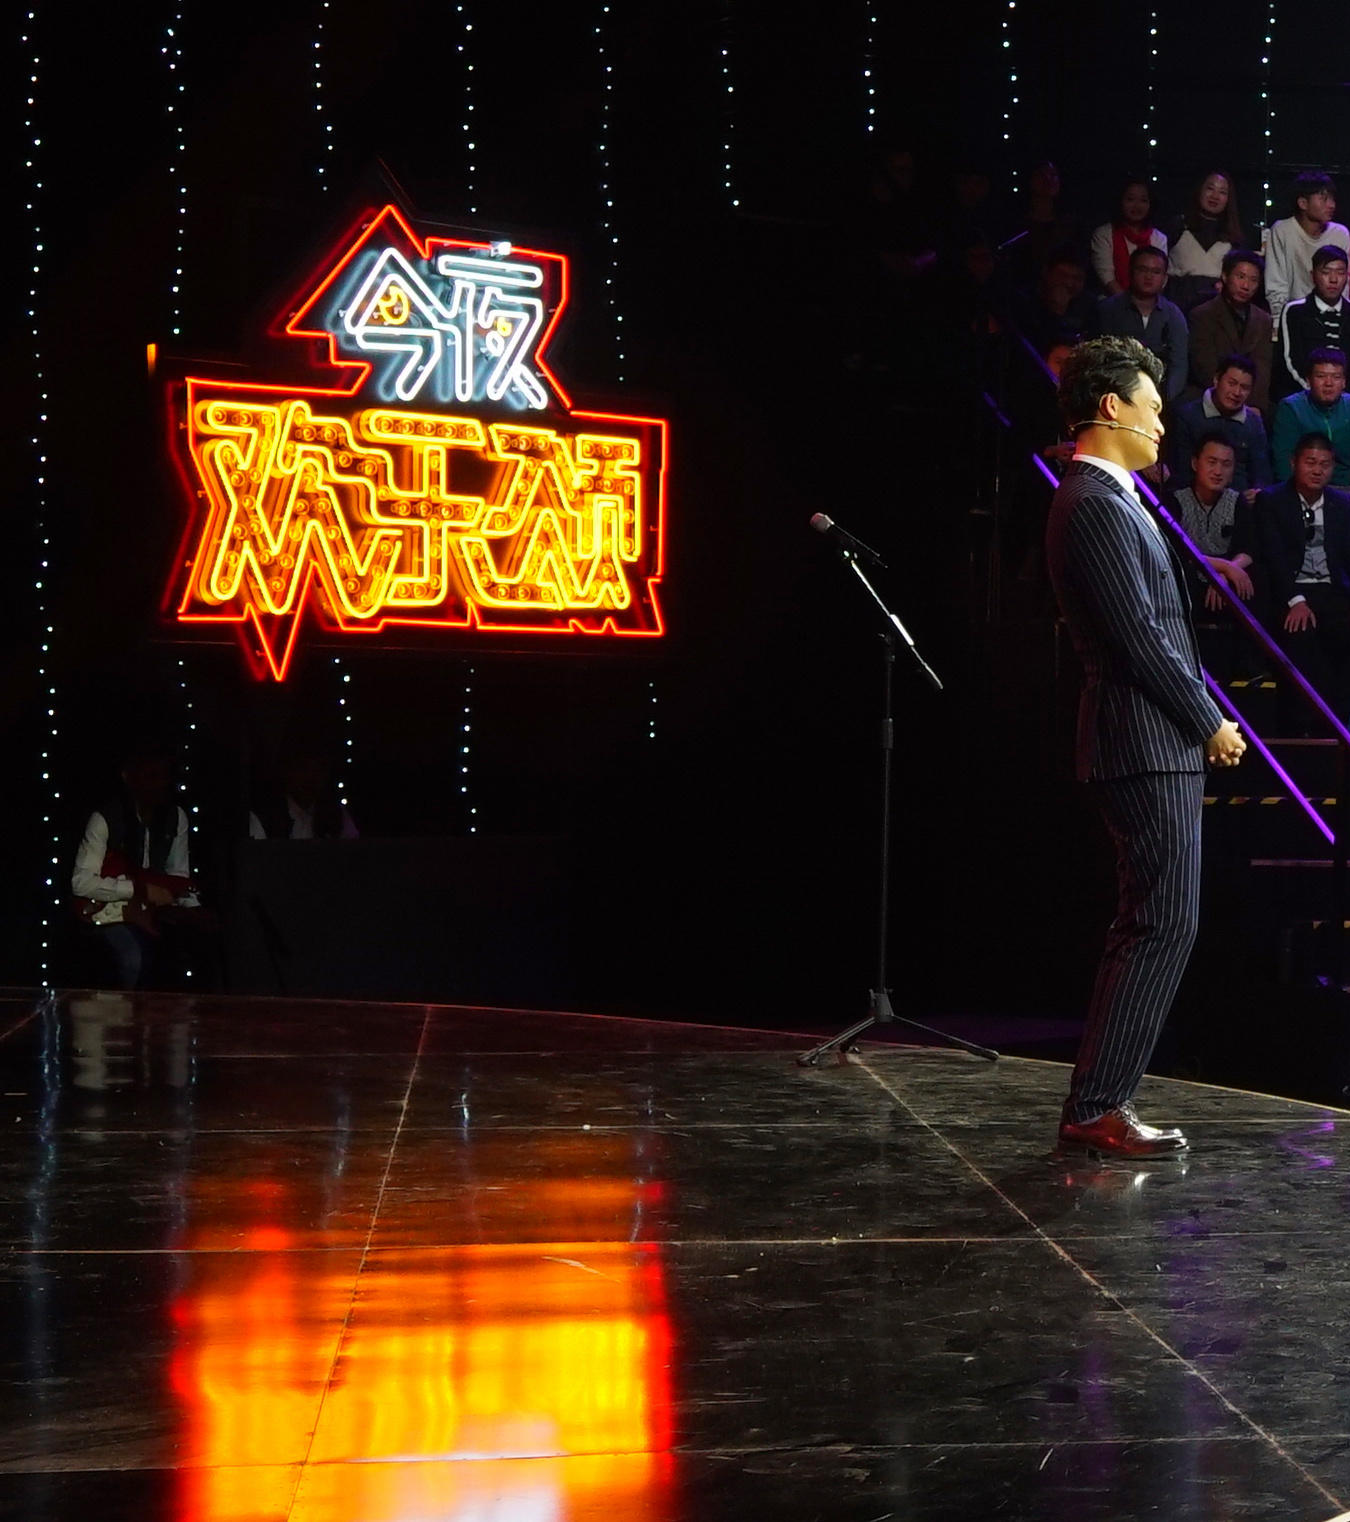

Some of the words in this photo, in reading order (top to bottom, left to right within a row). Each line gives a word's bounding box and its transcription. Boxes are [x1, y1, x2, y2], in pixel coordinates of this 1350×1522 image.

[342, 246, 549, 411] 今夜
[198, 399, 642, 619] 欢乐颂
